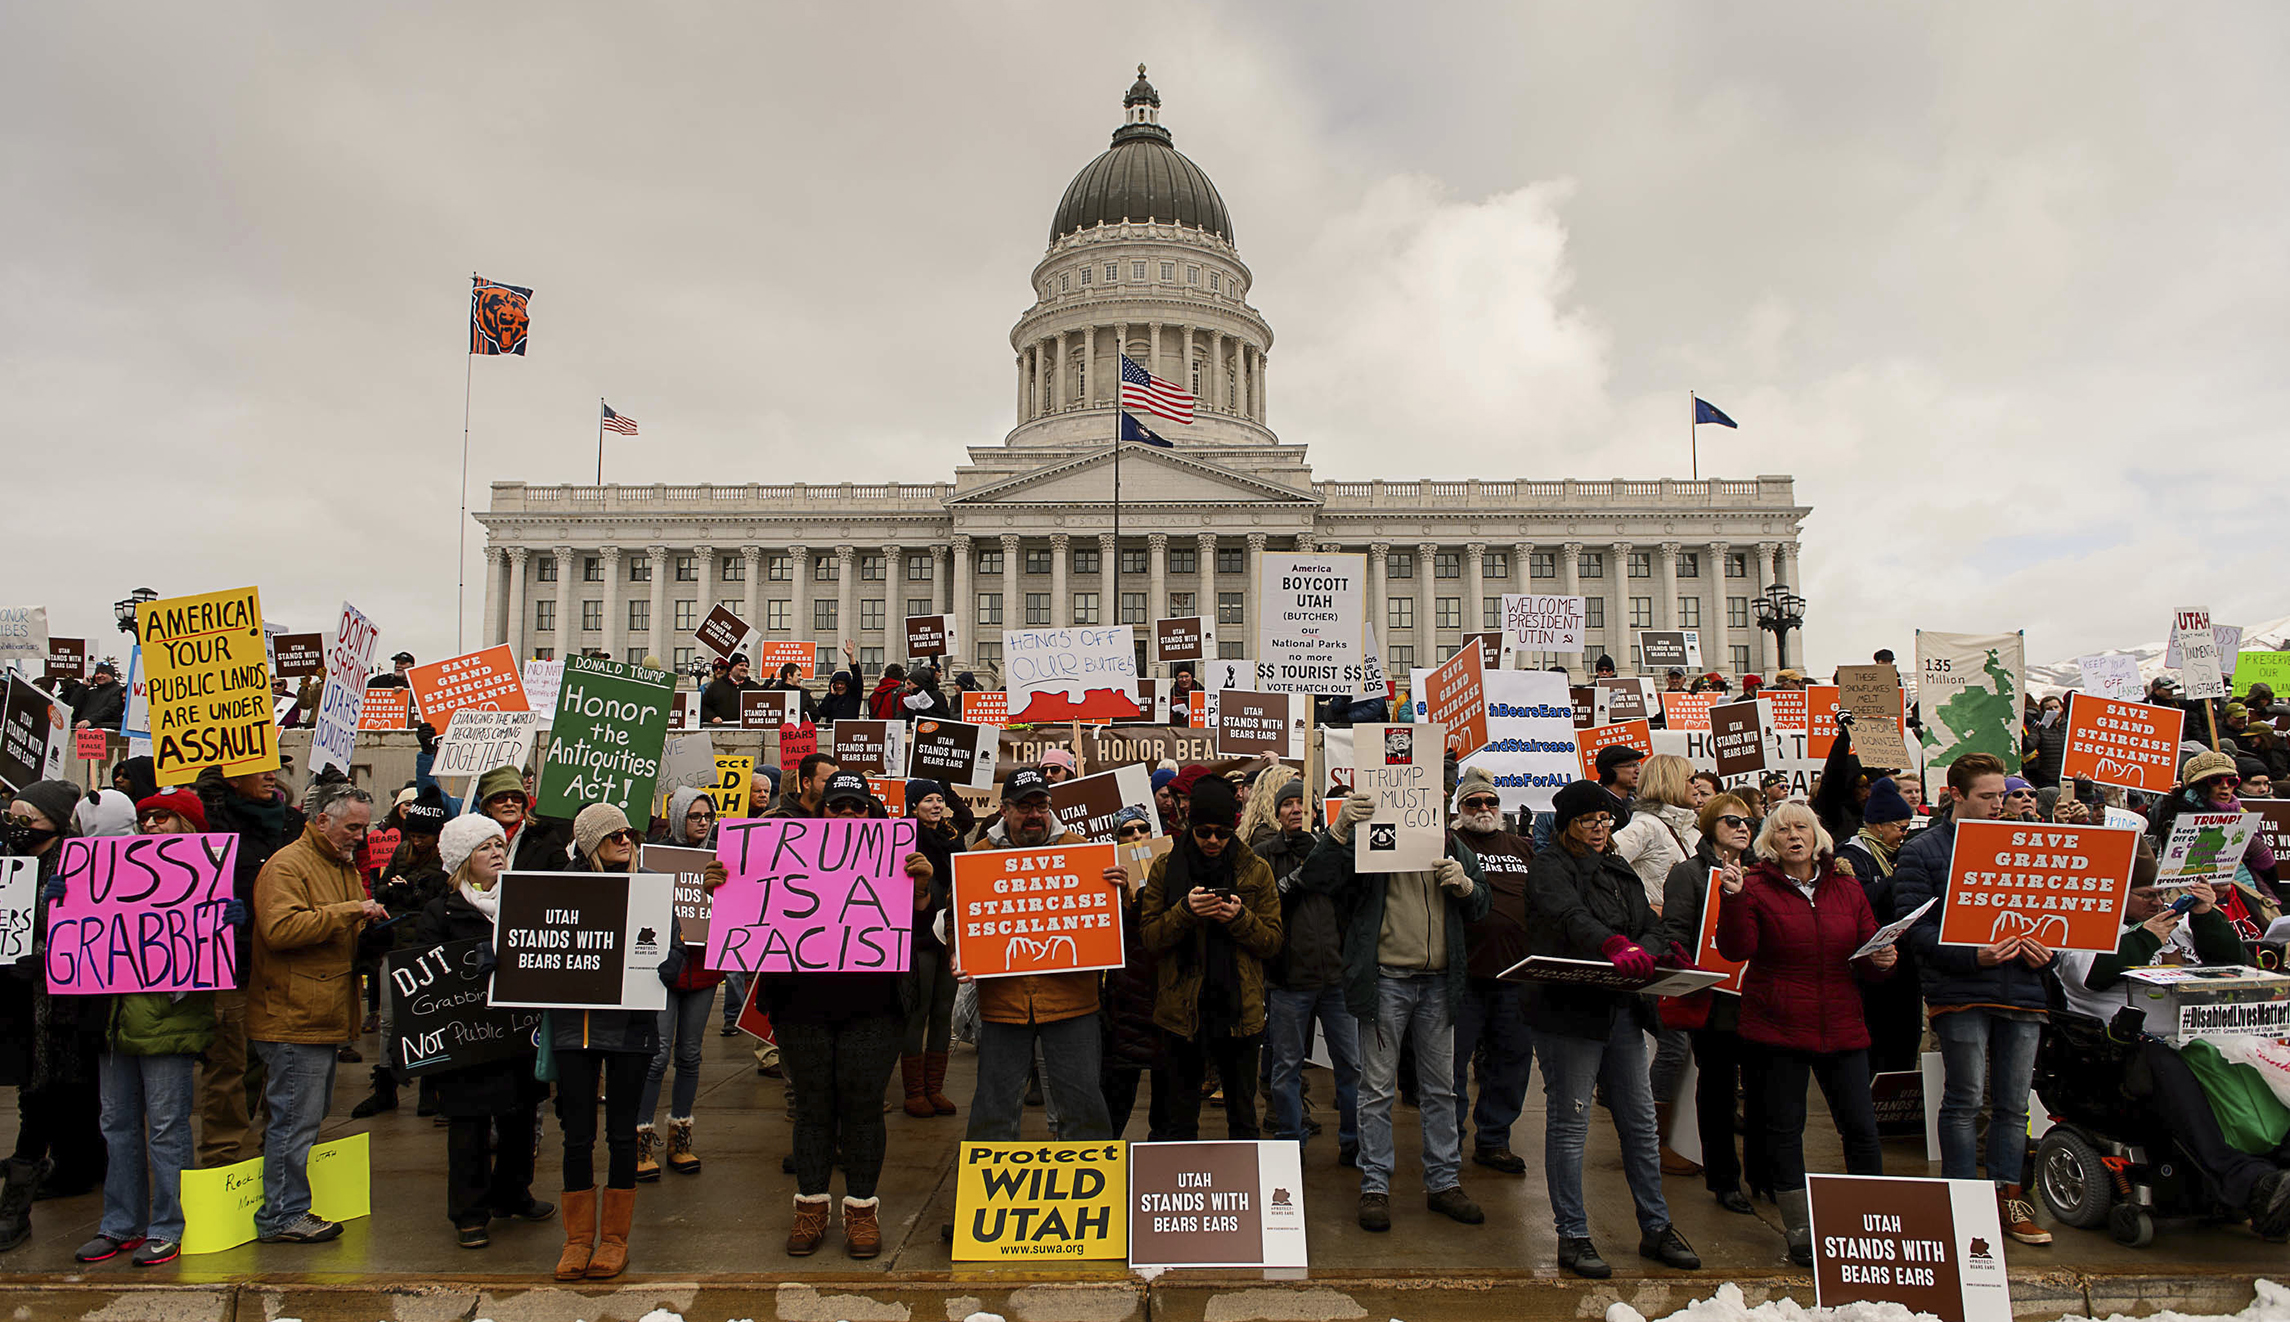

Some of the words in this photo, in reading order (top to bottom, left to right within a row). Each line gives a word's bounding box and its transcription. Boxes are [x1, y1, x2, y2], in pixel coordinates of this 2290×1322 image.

[1079, 517, 1113, 525] STAT
[1128, 517, 1143, 525] OF
[1151, 517, 1187, 525] UTAH
[1292, 564, 1331, 573] America
[1282, 577, 1348, 591] BOYCOTT
[1296, 594, 1332, 608] UTAH
[1506, 597, 1578, 616] WELCOME
[145, 595, 258, 642] AMERICA!
[1283, 611, 1338, 622] (BUTCHER)
[1508, 614, 1583, 631] PRESIDENT
[2178, 612, 2210, 630] UTAH
[339, 611, 377, 661] DON'T
[1080, 629, 1121, 646] OFF
[1272, 639, 1314, 648] National
[1319, 640, 1347, 649] Parks
[164, 636, 232, 669] YOUR
[330, 646, 369, 696] SHRINK
[442, 656, 481, 673] SAVE
[576, 657, 623, 674] DONALD
[631, 665, 666, 683] TRUMP
[1012, 653, 1079, 681] OUR
[1257, 662, 1275, 679] $$
[1281, 665, 1338, 680] TOURIST
[1343, 664, 1362, 681] $$
[1442, 658, 1464, 682] SAVE
[2083, 658, 2106, 670] KEEP
[2259, 668, 2278, 678] OUR
[149, 671, 214, 705] PUBLIC
[222, 663, 267, 691] LANDS
[437, 666, 492, 686] GRAND
[1854, 673, 1878, 682] THESE
[1926, 674, 1965, 684] Million
[2104, 678, 2123, 688] OFF
[424, 673, 513, 703] STAIRCASE
[1267, 683, 1293, 692] VOTE
[1296, 684, 1328, 693] HATCH
[1330, 684, 1352, 693] OUT
[1440, 673, 1469, 701] GRAND
[1845, 684, 1890, 694] SNOWFLAKES
[2118, 685, 2144, 697] LANDS
[2187, 681, 2222, 695] MISTAKE
[324, 681, 359, 726] UTAH'S
[426, 683, 517, 715] ESCALANTE
[564, 684, 657, 725] Honor
[1432, 684, 1480, 723] STAIRCASE
[1857, 695, 1879, 703] MELT
[161, 706, 199, 730] ARE
[209, 695, 265, 720] UNDER
[1243, 707, 1263, 716] UTAH
[1853, 705, 1885, 714] CHEETOS
[2106, 704, 2148, 720] SAVE
[452, 713, 494, 725] CHANGING
[495, 713, 511, 725] THE
[511, 713, 536, 724] WORLD
[1223, 717, 1259, 728] STANDS
[1262, 718, 1283, 730] WITH
[1729, 721, 1743, 732] UTAH
[2097, 717, 2155, 735] GRAND
[451, 727, 492, 741] REQUIRES
[492, 726, 521, 740] COMING
[590, 723, 629, 746] the
[781, 730, 814, 741] BEARS
[1230, 730, 1255, 739] BEARS
[1257, 731, 1277, 741] EARS
[1850, 723, 1867, 732] GO
[1869, 723, 1900, 734] HOME
[156, 719, 271, 769] ASSAULT
[837, 744, 864, 752] STANDS
[866, 744, 883, 752] WITH
[937, 737, 954, 746] UTAH
[1716, 734, 1742, 748] STANDS
[1743, 731, 1758, 743] WITH
[2077, 728, 2171, 753] STAIRCASE
[441, 742, 522, 771] TOGETHER
[786, 745, 811, 754] FALSE
[919, 744, 950, 757] STANDS
[951, 748, 971, 760] WITH
[1097, 740, 1166, 761] HONOR
[1723, 747, 1741, 759] BEARS
[1742, 744, 1755, 755] EARS
[2073, 742, 2171, 767] ESCALANTE
[547, 737, 657, 782] Antiquities
[923, 755, 944, 766] BEARS
[946, 758, 963, 769] EARS
[833, 782, 862, 790] TRUMP
[837, 775, 859, 783] DUMP
[1364, 767, 1424, 788] TRUMP
[563, 774, 633, 809] Act!
[1381, 788, 1430, 809] MUST
[1404, 808, 1437, 828] GO!
[2194, 815, 2243, 825] TRUMP!
[369, 834, 399, 844] BEARS
[2011, 831, 2079, 849] SAVE
[726, 822, 915, 877] TRUMP
[1005, 855, 1066, 873] SAVE
[1504, 864, 1528, 874] EARS
[1995, 852, 2089, 871] GRAND
[56, 835, 235, 917] PUSSY
[993, 874, 1080, 894] GRAND
[1963, 871, 2114, 892] STAIRCASE
[745, 875, 820, 927] IS
[839, 875, 891, 928] A
[968, 893, 1107, 917] STAIRCASE
[1958, 891, 2113, 913] ESCALANTE
[545, 909, 579, 925] UTAH
[967, 913, 1111, 937] ESCALANTE
[47, 898, 237, 989] GRABBER
[508, 929, 570, 949] STANDS
[576, 931, 614, 950] WITH
[716, 926, 911, 972] RACIST
[518, 953, 561, 969] BEARS
[566, 954, 600, 970] EARS
[391, 945, 452, 997] DJT
[2182, 1003, 2290, 1028] #DisabledLivesMatter!
[2240, 1028, 2254, 1036] Party
[401, 1027, 446, 1064] NOT
[448, 1020, 504, 1047] Public
[969, 1144, 1118, 1165] Protect
[981, 1168, 1105, 1201] WILD
[1178, 1172, 1211, 1188] UTAH
[1141, 1194, 1204, 1212] STANDS
[1211, 1192, 1248, 1211] WITH
[972, 1206, 1110, 1243] UTAH
[1154, 1217, 1197, 1233] BEARS
[1203, 1216, 1238, 1232] EARS
[1863, 1214, 1901, 1233] UTAH
[1000, 1243, 1083, 1255] www.suwa.org
[1824, 1236, 1896, 1261] STANDS
[1902, 1240, 1945, 1262] WITH
[1841, 1264, 1890, 1285] BEARS
[1896, 1267, 1935, 1287] EARS
